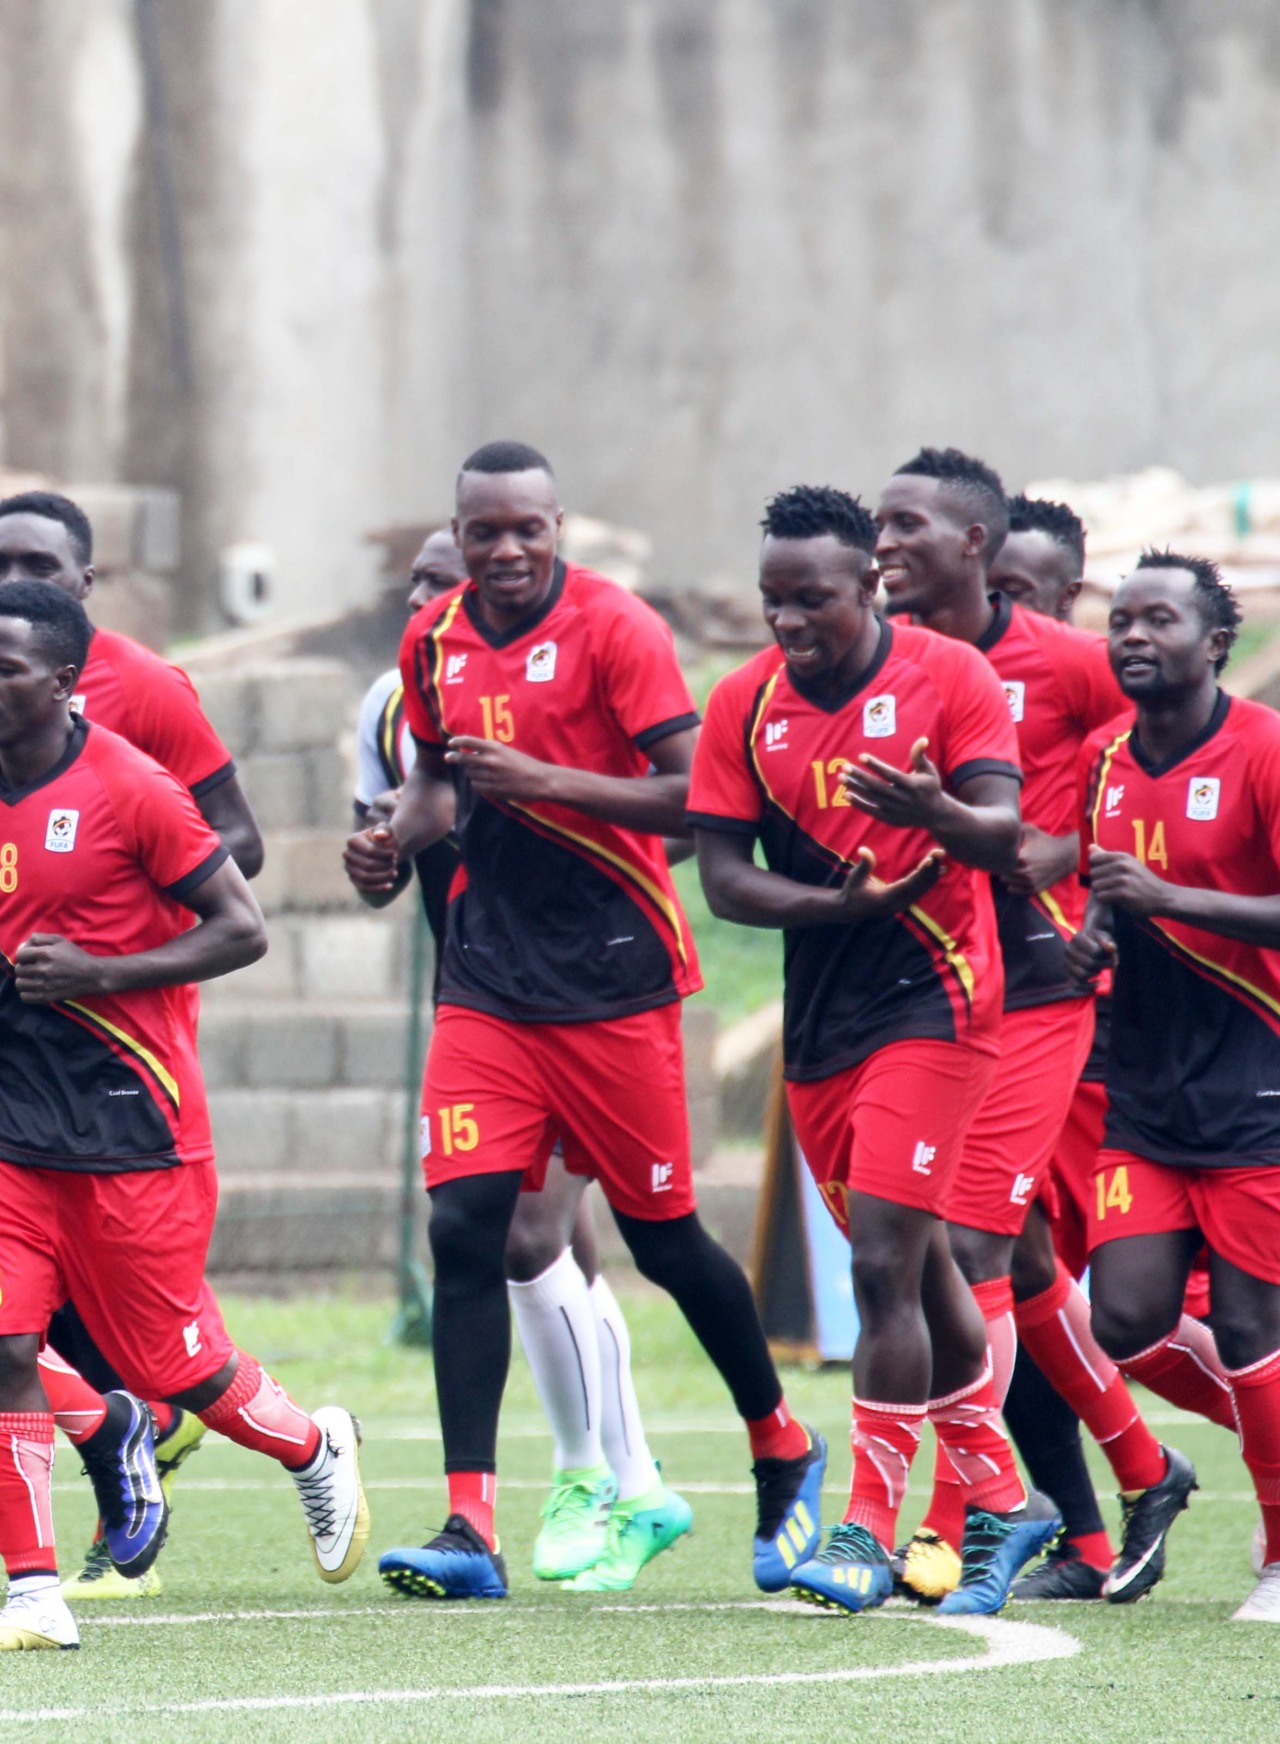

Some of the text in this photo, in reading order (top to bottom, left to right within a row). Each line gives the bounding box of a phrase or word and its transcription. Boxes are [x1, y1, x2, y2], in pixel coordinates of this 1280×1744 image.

[478, 694, 515, 743] 15
[811, 756, 851, 809] 12
[50, 841, 67, 849] FUFA
[1131, 818, 1167, 870] 14
[438, 1104, 479, 1155] 15
[1095, 1166, 1132, 1221] 14
